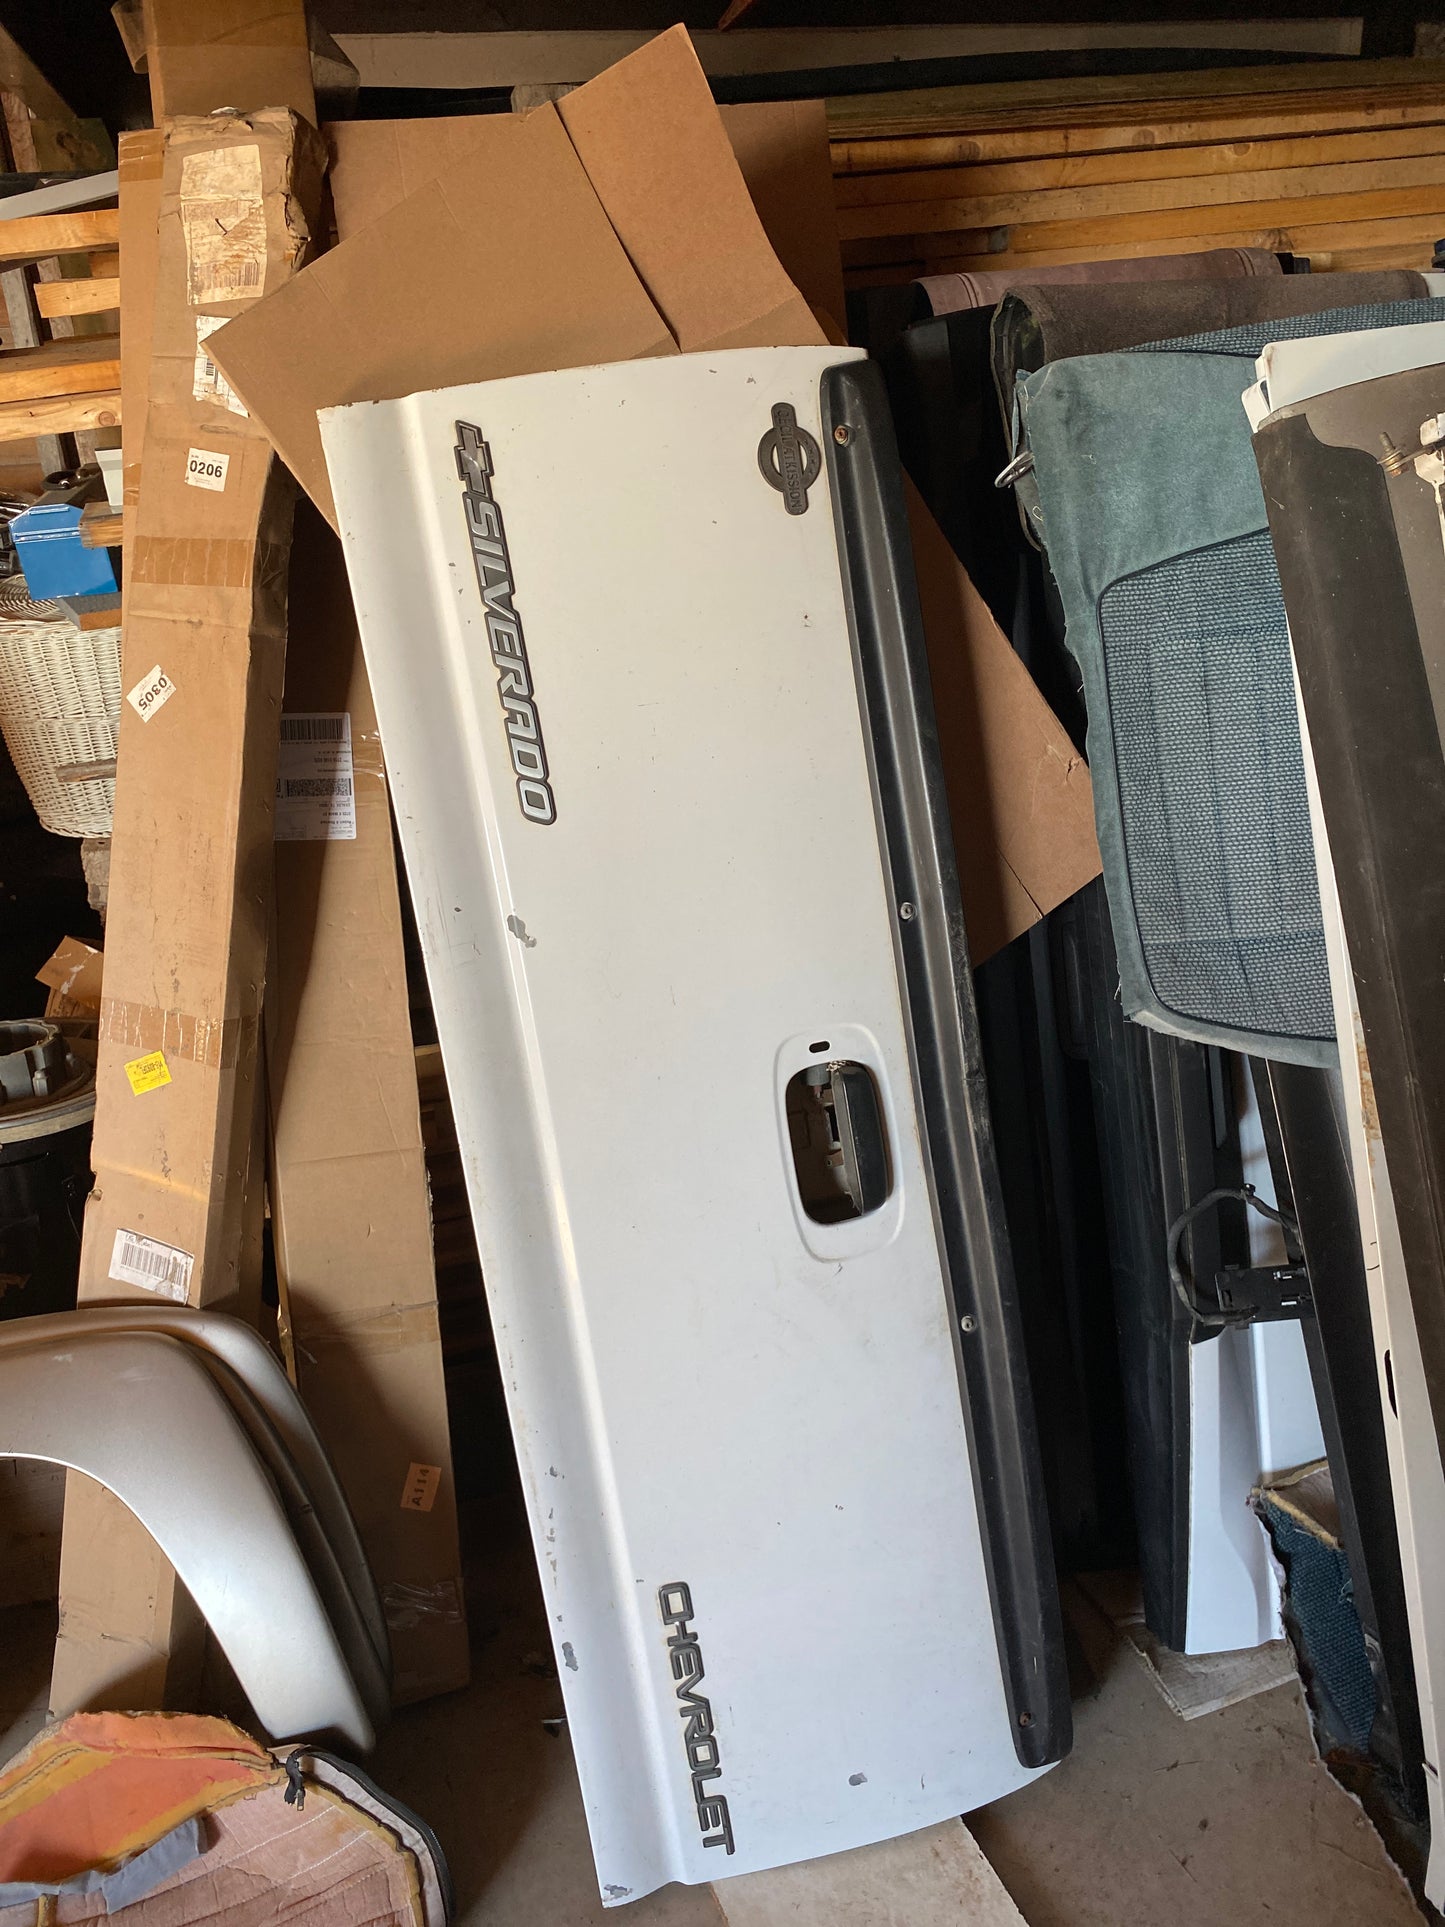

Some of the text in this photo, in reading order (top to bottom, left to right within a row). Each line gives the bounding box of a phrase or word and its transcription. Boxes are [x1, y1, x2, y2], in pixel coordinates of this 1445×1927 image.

[189, 459, 223, 479] 0206
[776, 409, 803, 509] CECIL ATKISSION
[138, 677, 168, 711] 0305
[464, 495, 556, 824] SILVERADO
[658, 1580, 736, 1856] CHEVROLET
